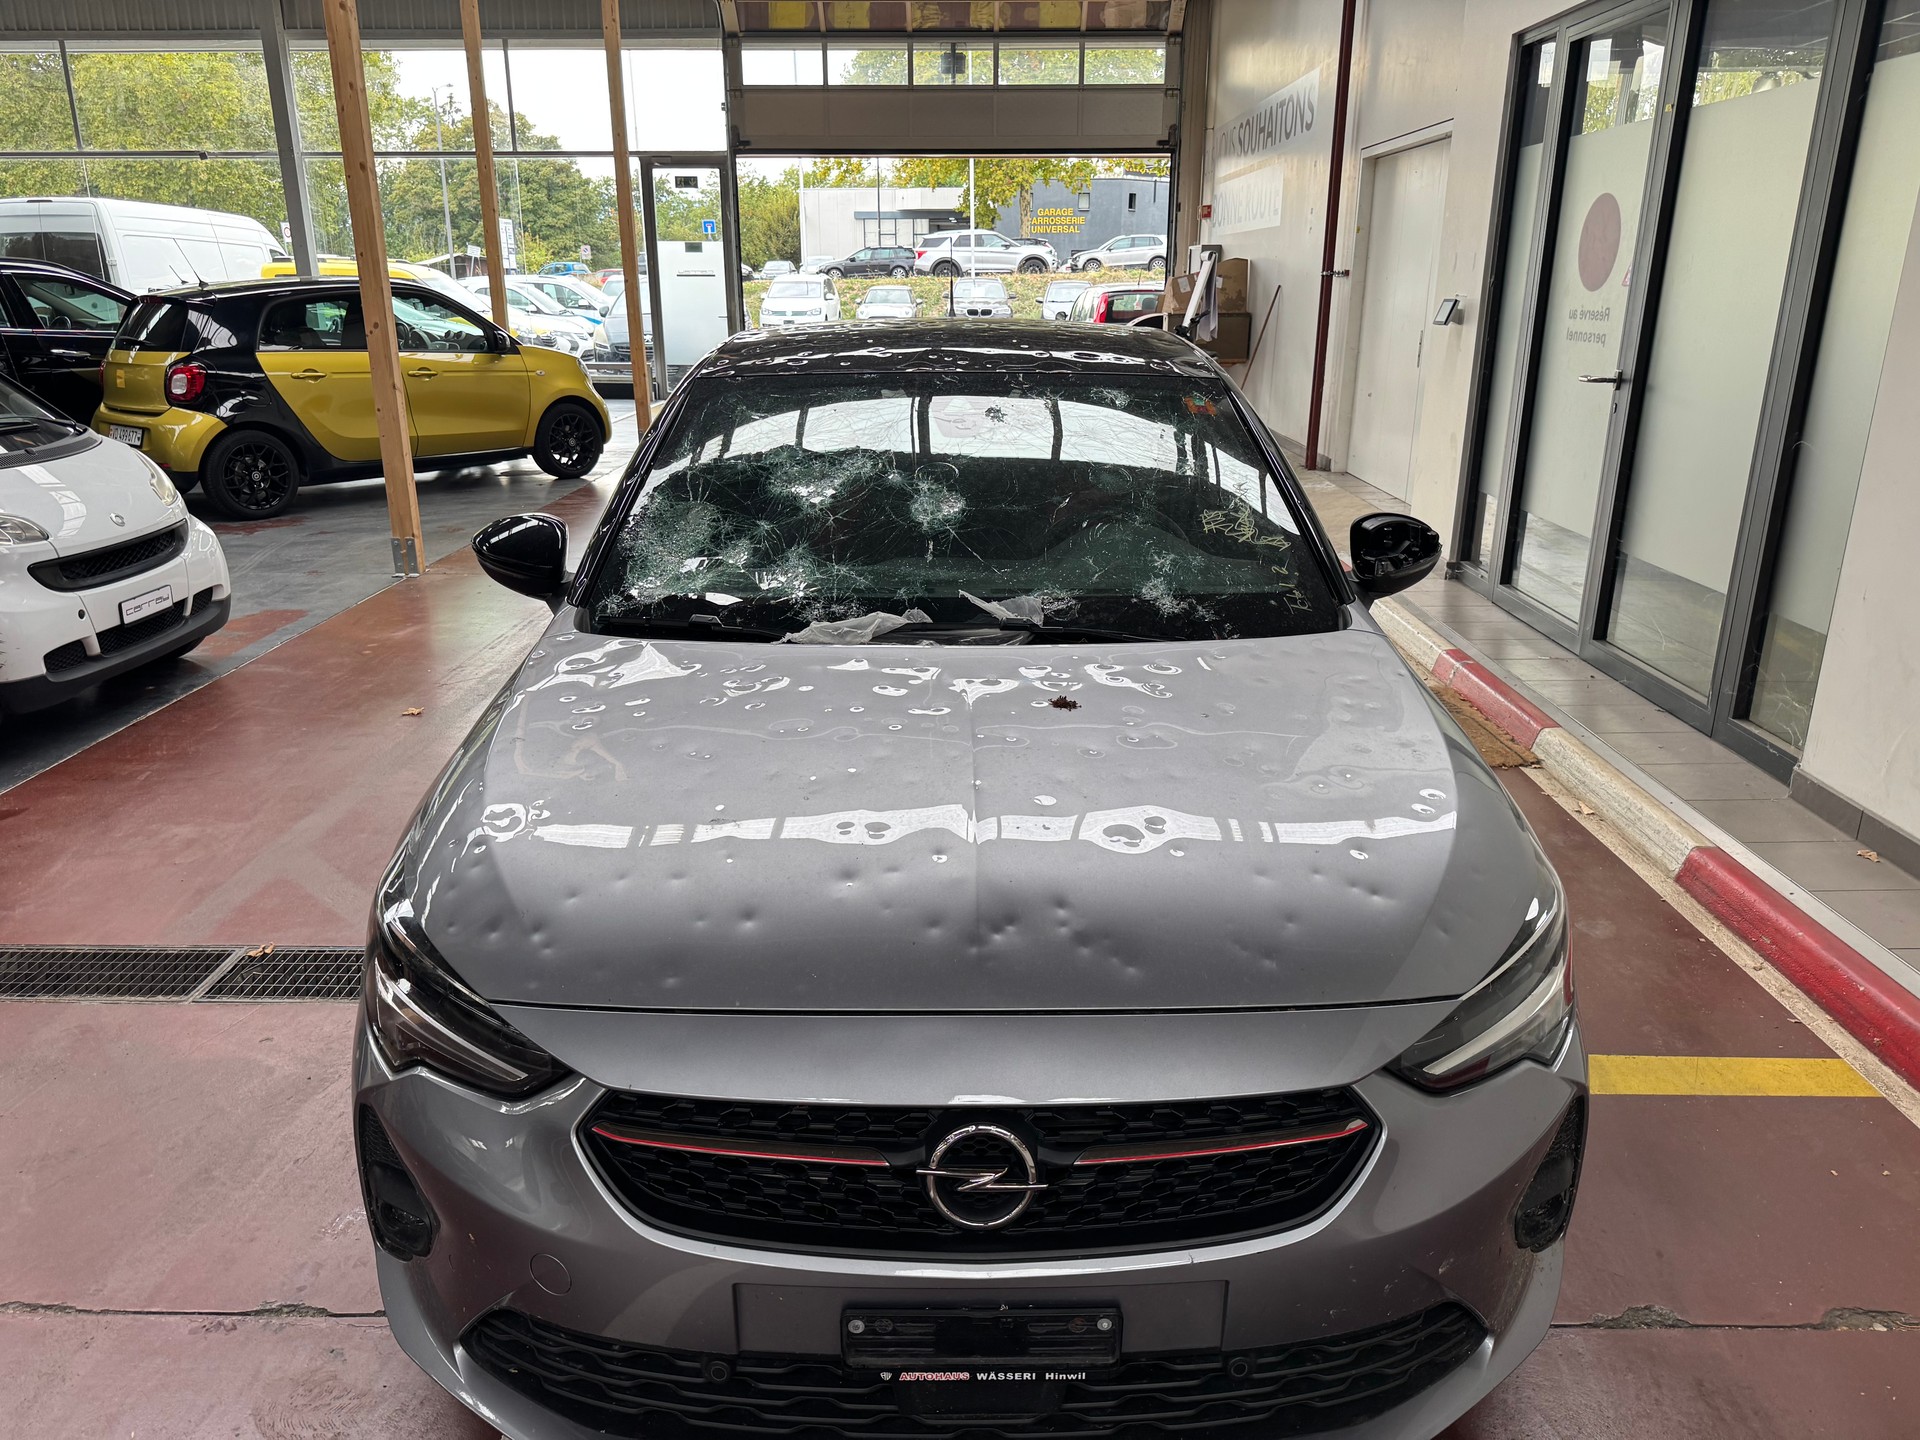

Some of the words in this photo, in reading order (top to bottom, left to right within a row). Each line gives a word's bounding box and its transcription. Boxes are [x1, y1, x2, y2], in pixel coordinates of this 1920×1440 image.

[1238, 86, 1315, 157] SOUHAITONS
[1037, 208, 1073, 216] GARAGE
[1030, 216, 1085, 225] ARROSSERIE
[1031, 225, 1080, 233] UNIVERSAL
[899, 1372, 970, 1381] AUTOHAUS
[976, 1371, 1036, 1381] WÄSSERI
[1045, 1372, 1086, 1381] Hinwil
